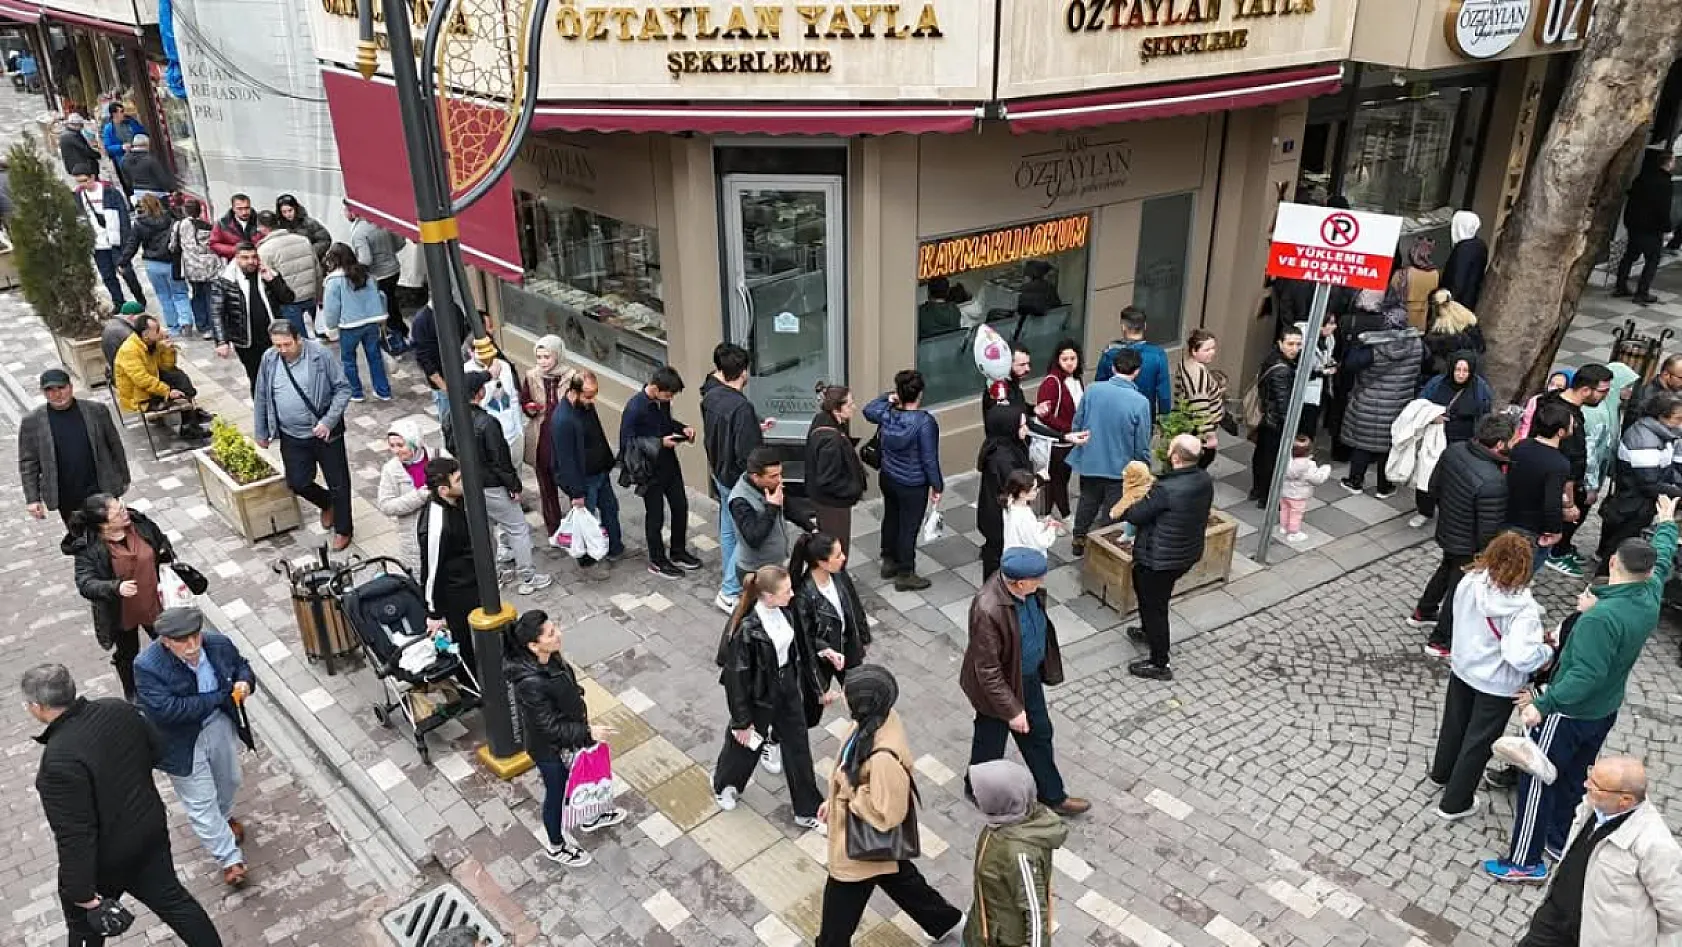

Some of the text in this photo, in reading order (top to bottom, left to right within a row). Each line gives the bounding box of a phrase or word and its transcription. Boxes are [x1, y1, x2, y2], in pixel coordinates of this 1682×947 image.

[556, 0, 944, 41] ÖZTAYLAN YAYLA
[1141, 29, 1248, 64] ŞEKERLEME
[667, 51, 832, 80] ŞEKERLEME
[1278, 255, 1379, 279] VE BOŞALTMA
[1295, 246, 1366, 265] YÜKLEME
